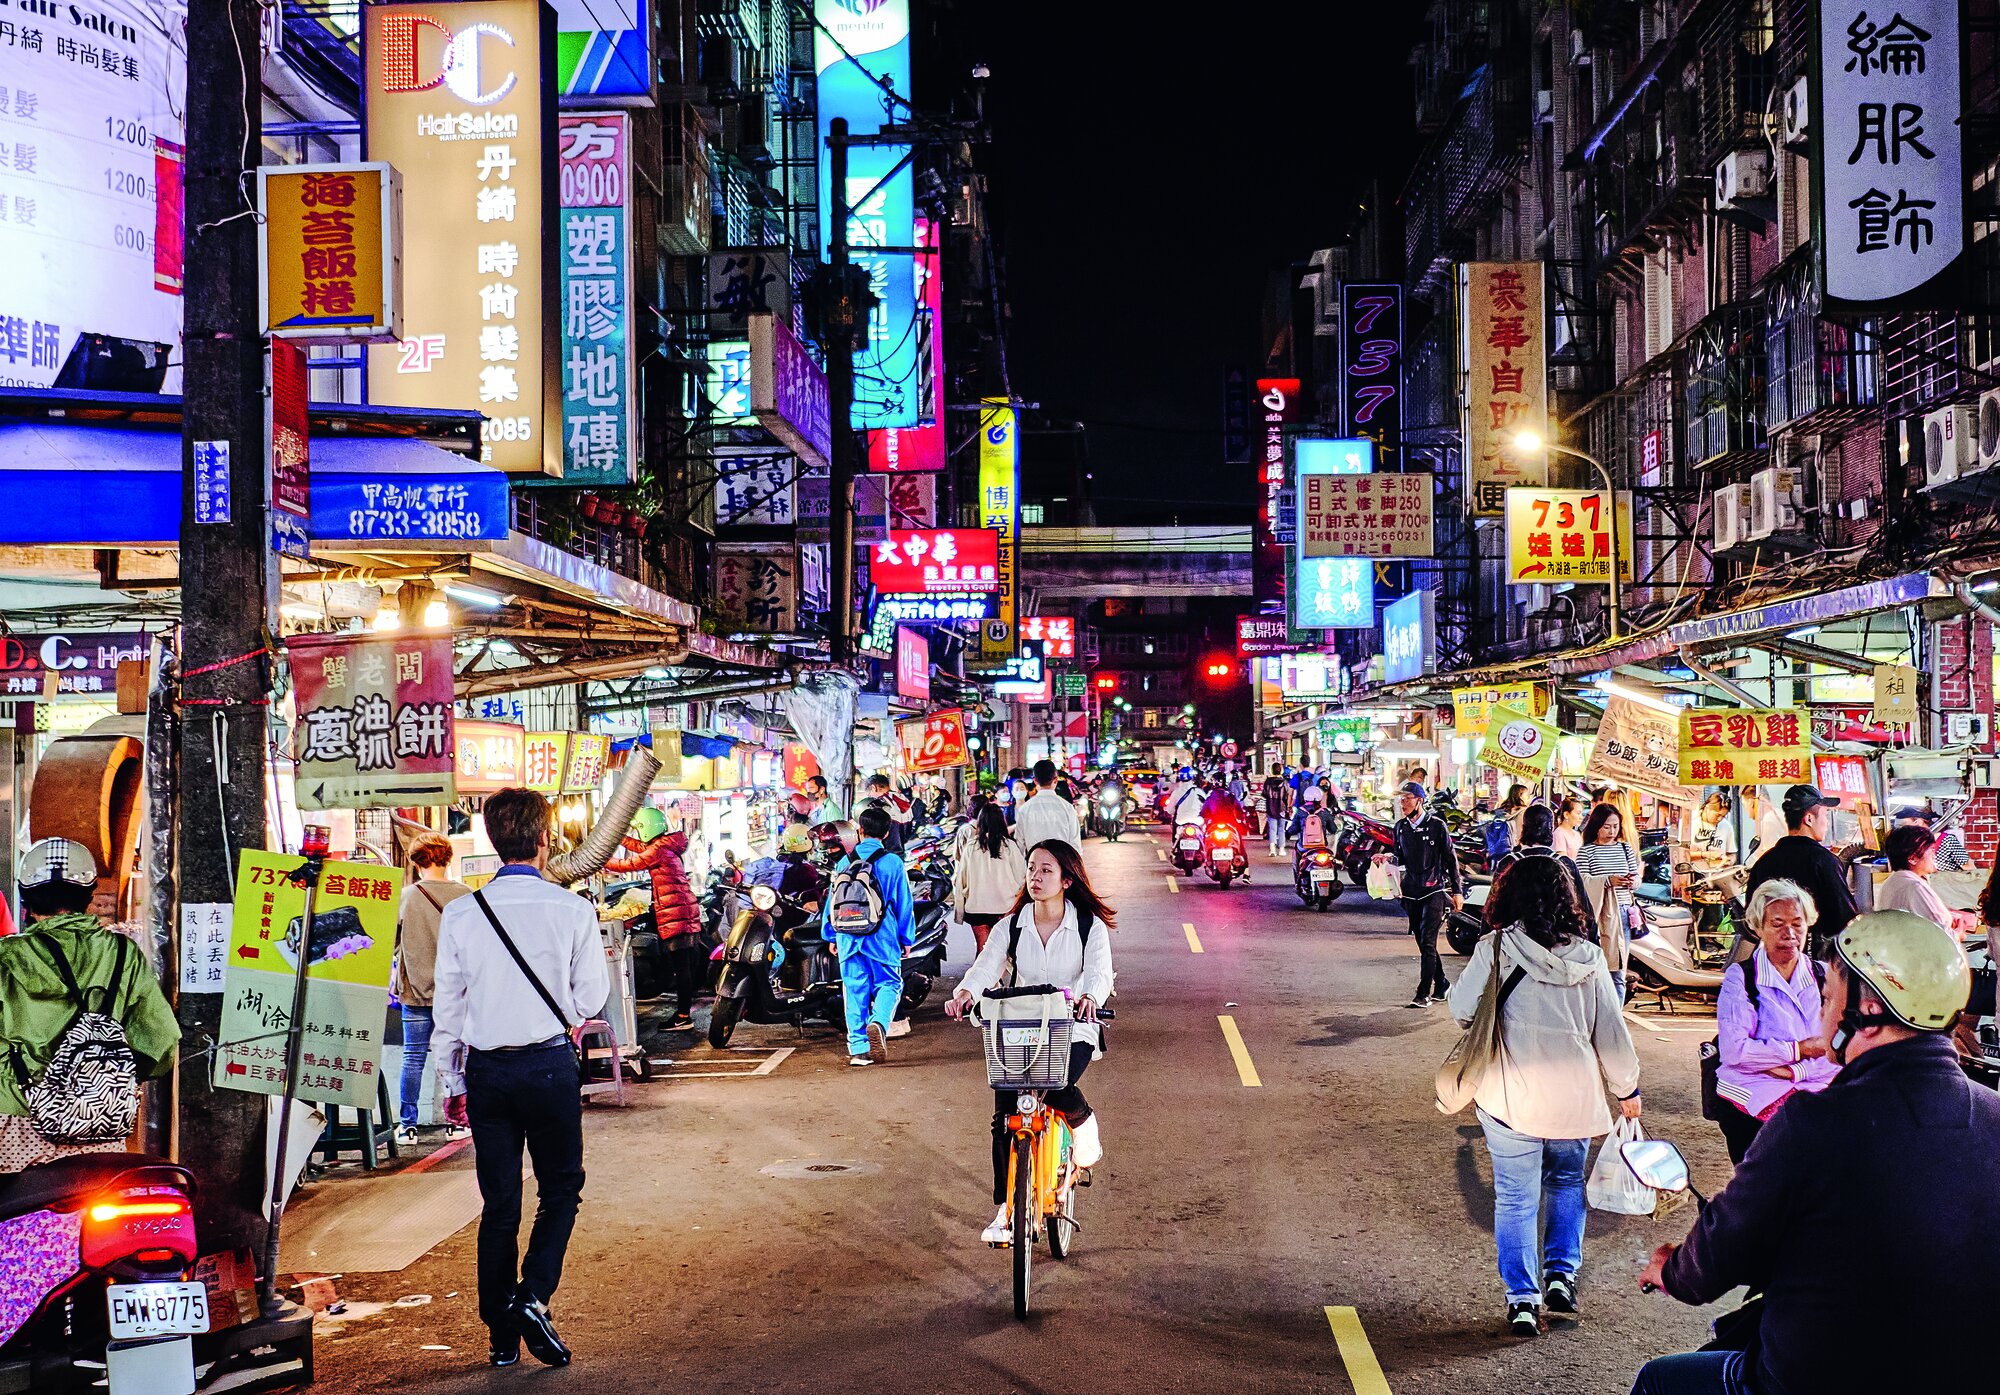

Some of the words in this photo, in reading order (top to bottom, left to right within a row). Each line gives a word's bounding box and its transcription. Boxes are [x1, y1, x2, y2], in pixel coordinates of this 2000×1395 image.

[69, 4, 137, 44] Salon
[836, 20, 885, 33] mentor
[0, 20, 43, 53] 丹綺
[57, 36, 140, 82] 時尚髮集
[381, 12, 518, 106] DC
[439, 131, 518, 142] HAIR/VOGUE/DESIGN
[1843, 10, 1937, 255] 綸服飾
[477, 144, 518, 223] 丹綺
[561, 163, 619, 205] 0900
[301, 174, 357, 315] 海苔飯捲
[478, 241, 520, 403] 時尚髮集
[399, 335, 444, 372] 2F
[567, 215, 620, 472] 塑膠地磚
[1348, 296, 1399, 424] 737
[1643, 434, 1660, 473] 租
[1308, 478, 1397, 494] 日式修手
[1400, 478, 1421, 493] 150
[1399, 496, 1422, 511] 250
[1474, 480, 1543, 512] 便
[350, 511, 480, 538] 8733-3858
[1400, 514, 1421, 529] 700
[876, 532, 958, 567] 大中華
[747, 559, 792, 631] 診所
[972, 583, 995, 592] Gold
[321, 650, 423, 688] 蟹老闆
[1884, 677, 1906, 695] 租
[1689, 714, 1800, 748] 豆乳雞
[528, 742, 557, 786] 排
[1607, 740, 1638, 763] 炒飯
[1645, 753, 1679, 778] 炒泡
[1691, 760, 1734, 780] 雞塊
[1759, 759, 1801, 780] 雞翅
[258, 891, 275, 941] 新鮮食材
[305, 1021, 371, 1043] 私房料理
